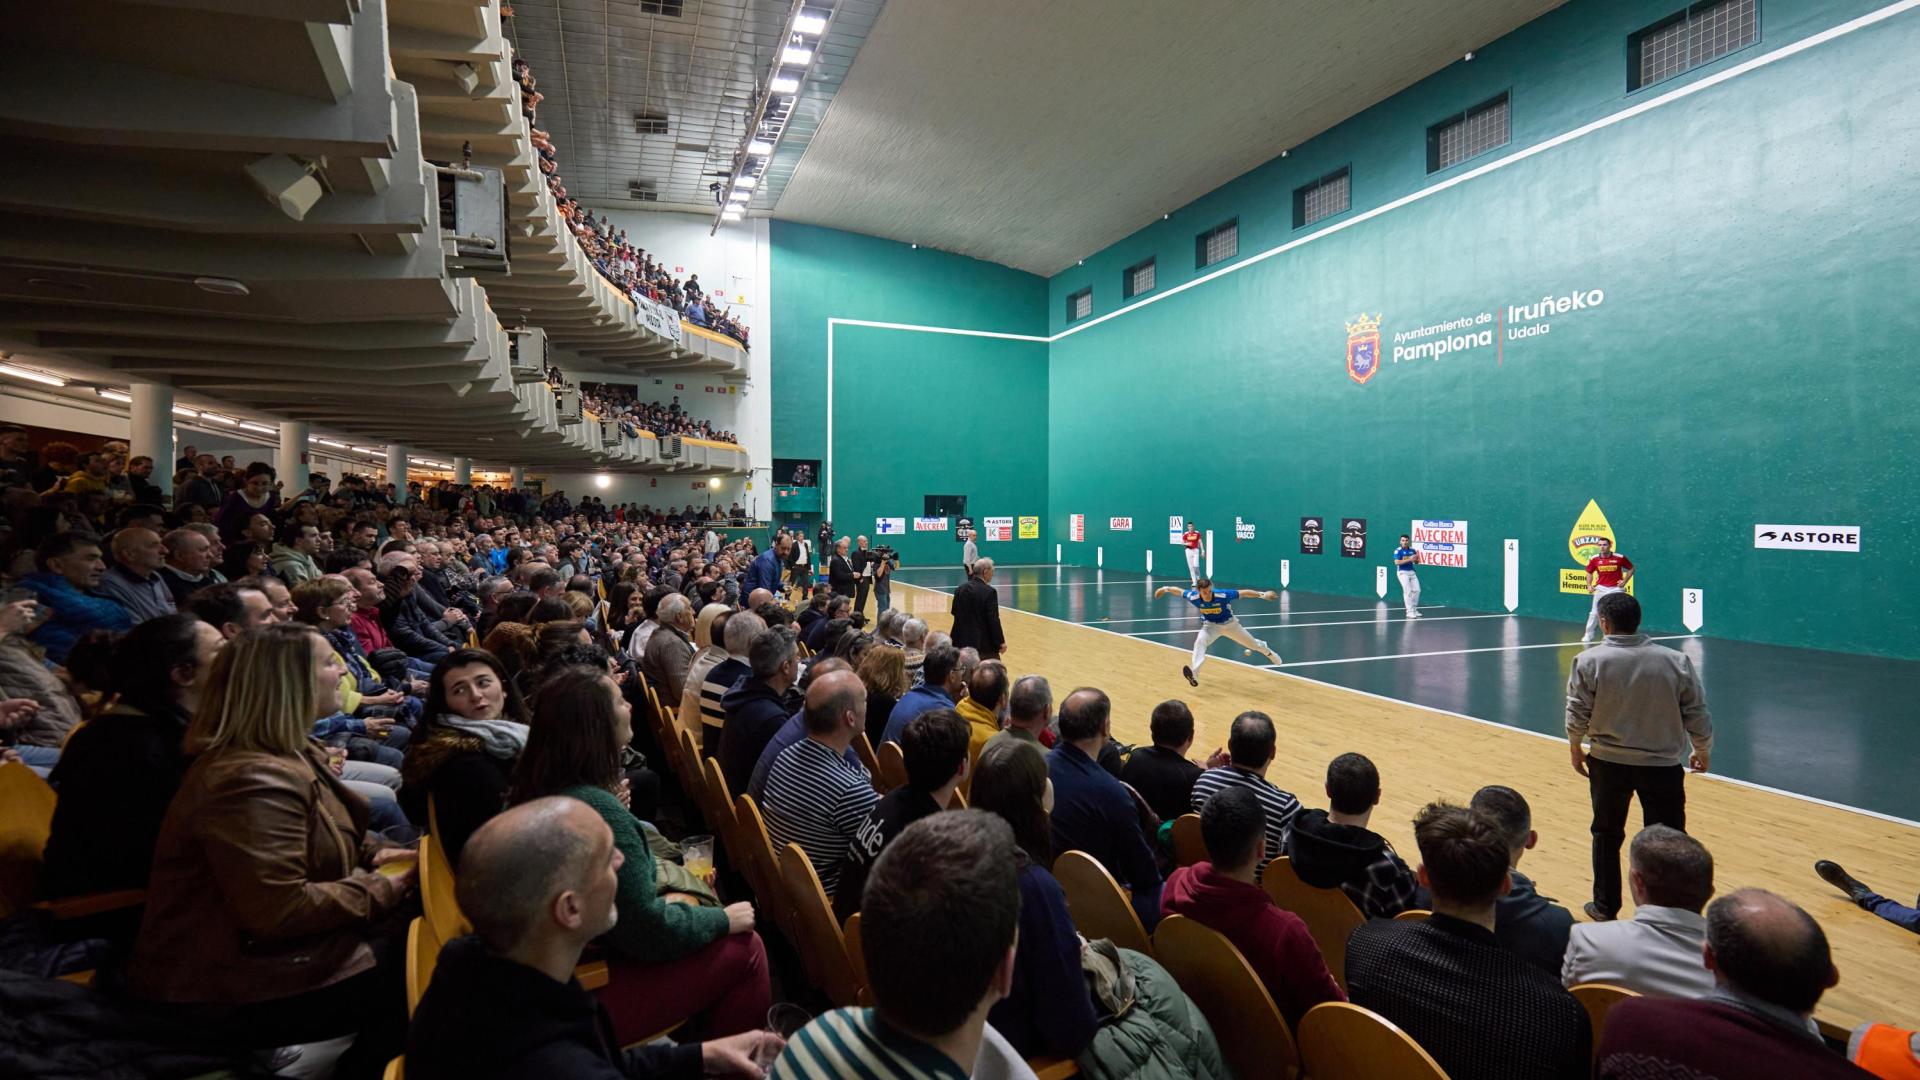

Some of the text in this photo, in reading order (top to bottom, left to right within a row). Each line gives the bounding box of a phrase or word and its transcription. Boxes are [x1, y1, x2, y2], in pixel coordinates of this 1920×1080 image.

[1508, 289, 1604, 323] Iruñeko
[1394, 312, 1492, 344] Ayuntamiento de
[1508, 323, 1550, 340] Udala
[1393, 330, 1492, 363] Pamplona
[1112, 518, 1130, 528] GARA
[1414, 527, 1464, 543] AVECREM
[1780, 531, 1858, 545] ASTORE
[1508, 541, 1514, 551] 4
[1689, 592, 1697, 604] 3
